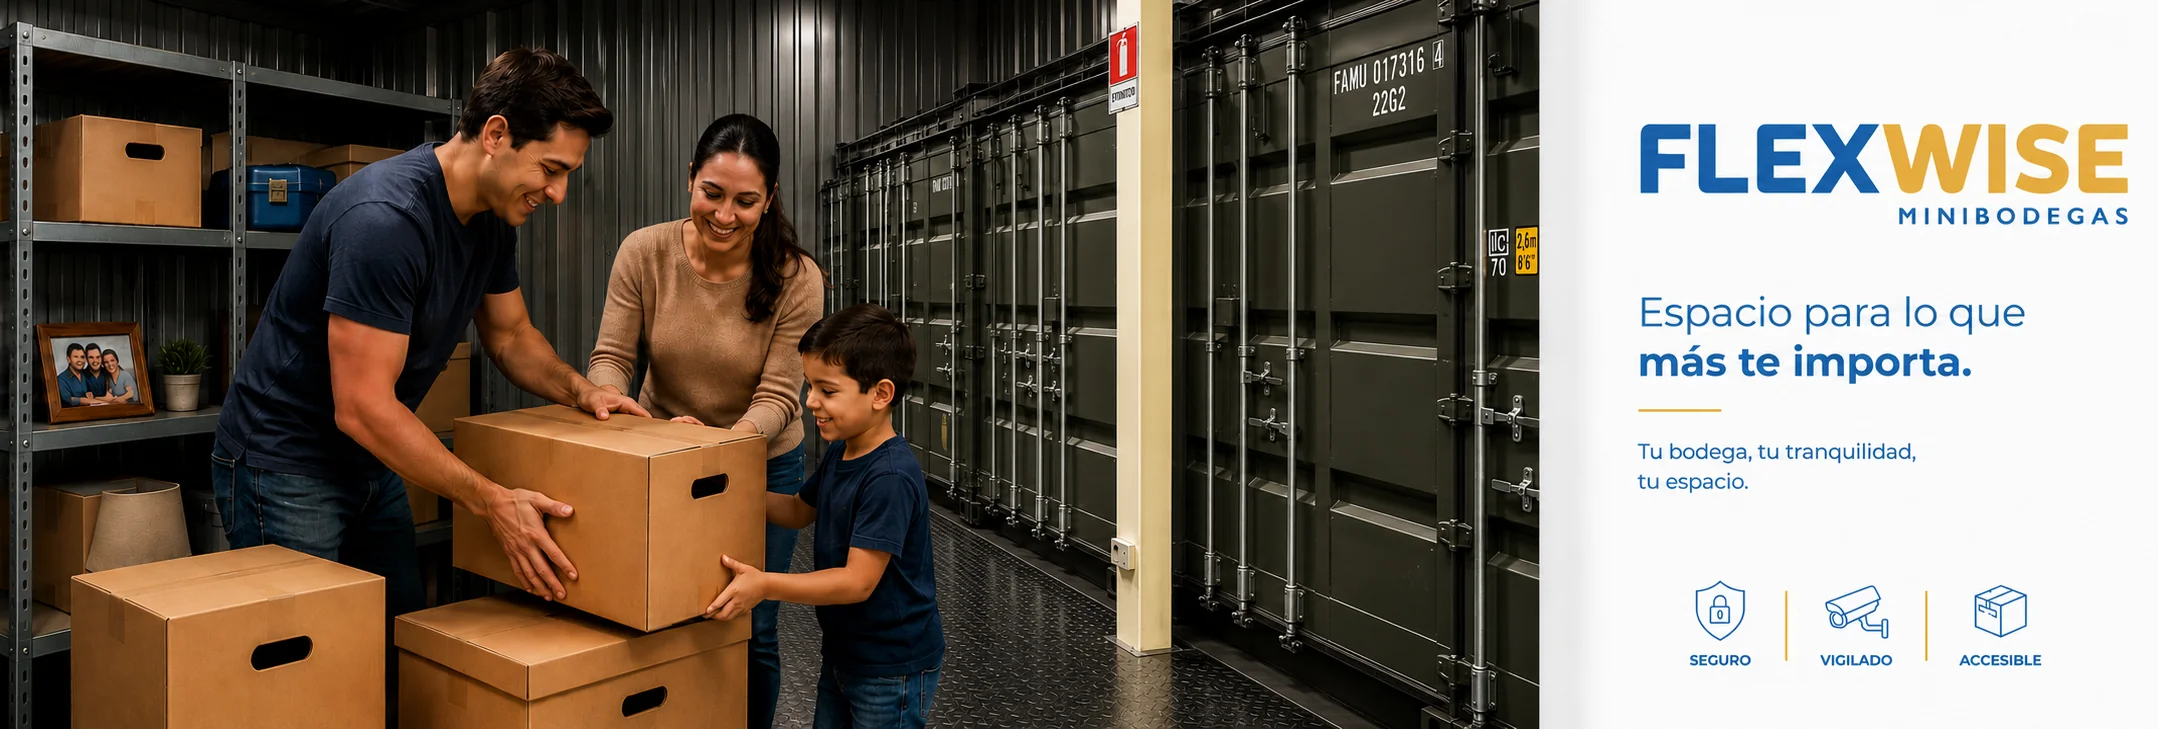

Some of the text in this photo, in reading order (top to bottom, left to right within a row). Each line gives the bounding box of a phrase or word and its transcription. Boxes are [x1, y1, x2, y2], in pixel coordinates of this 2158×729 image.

[1334, 41, 1444, 95] FAMU 017316 4
[1372, 85, 1406, 117] 22G2
[1516, 232, 1537, 252] 2,6m
[1491, 257, 1507, 277] 70
